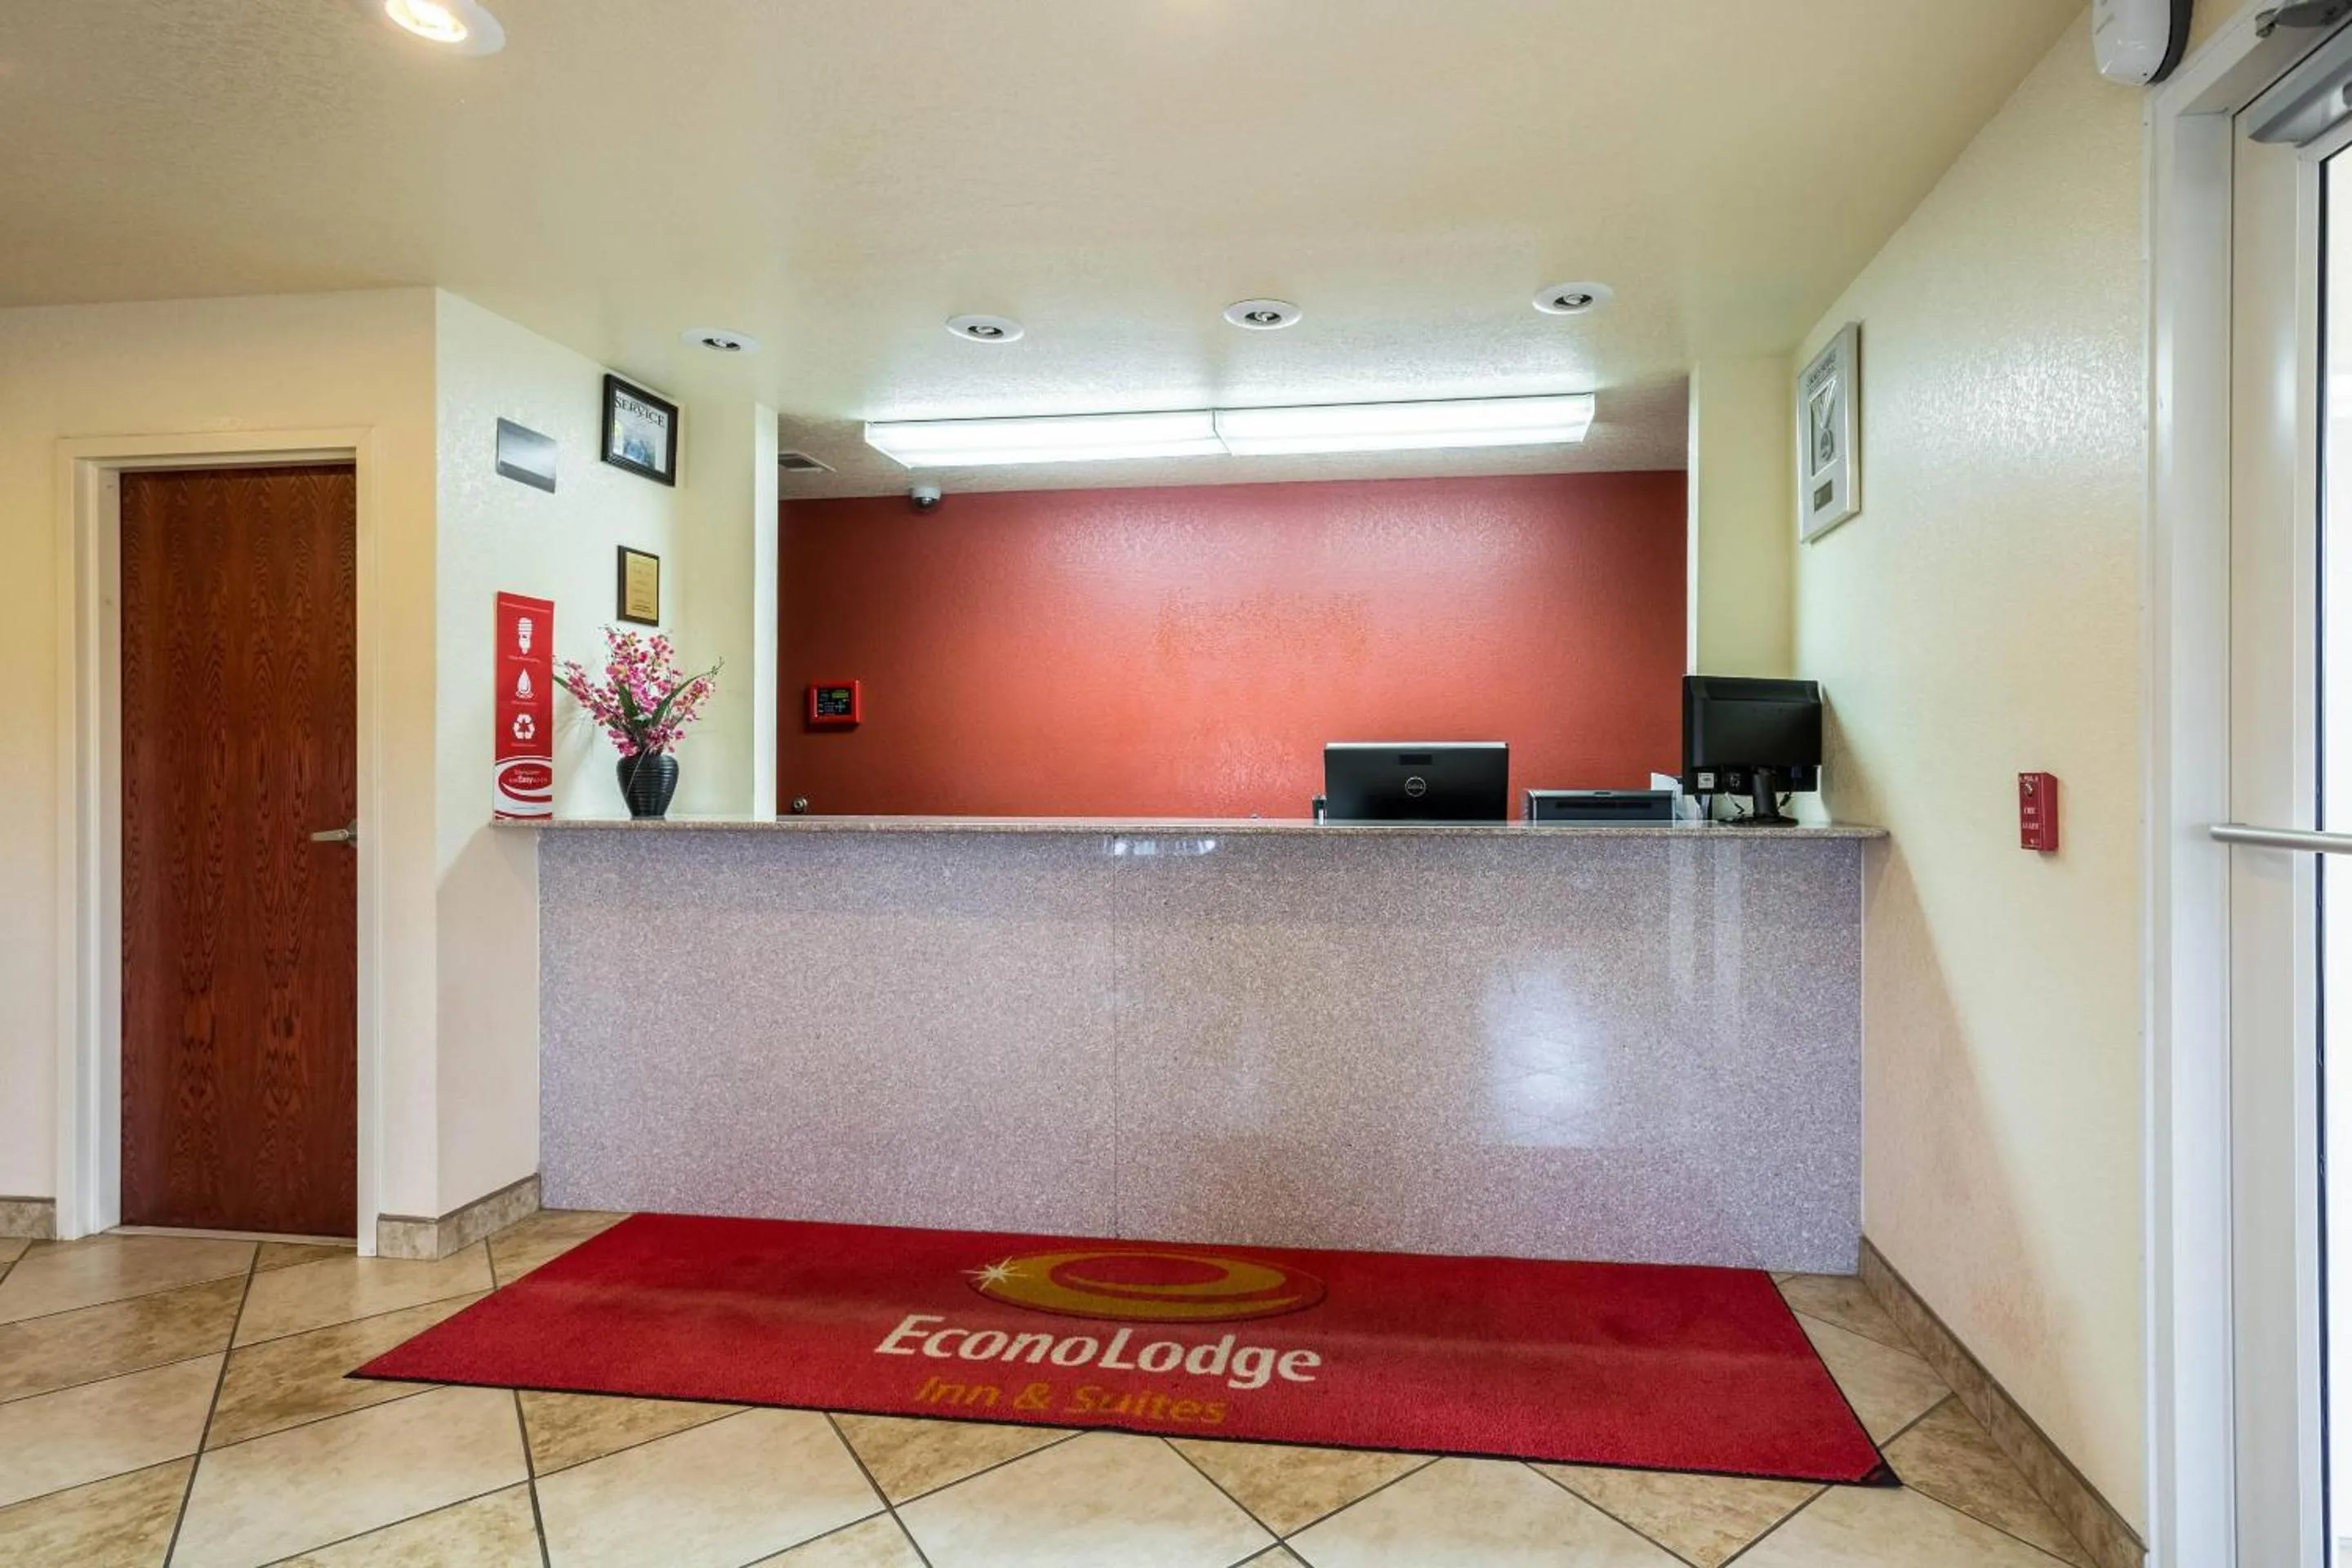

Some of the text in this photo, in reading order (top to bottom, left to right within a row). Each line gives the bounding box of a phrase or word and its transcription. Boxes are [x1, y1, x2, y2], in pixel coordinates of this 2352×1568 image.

[615, 396, 666, 426] SERVICE
[875, 1313, 1322, 1389] EconoLodge
[915, 1375, 1226, 1423] Inn & Suites
